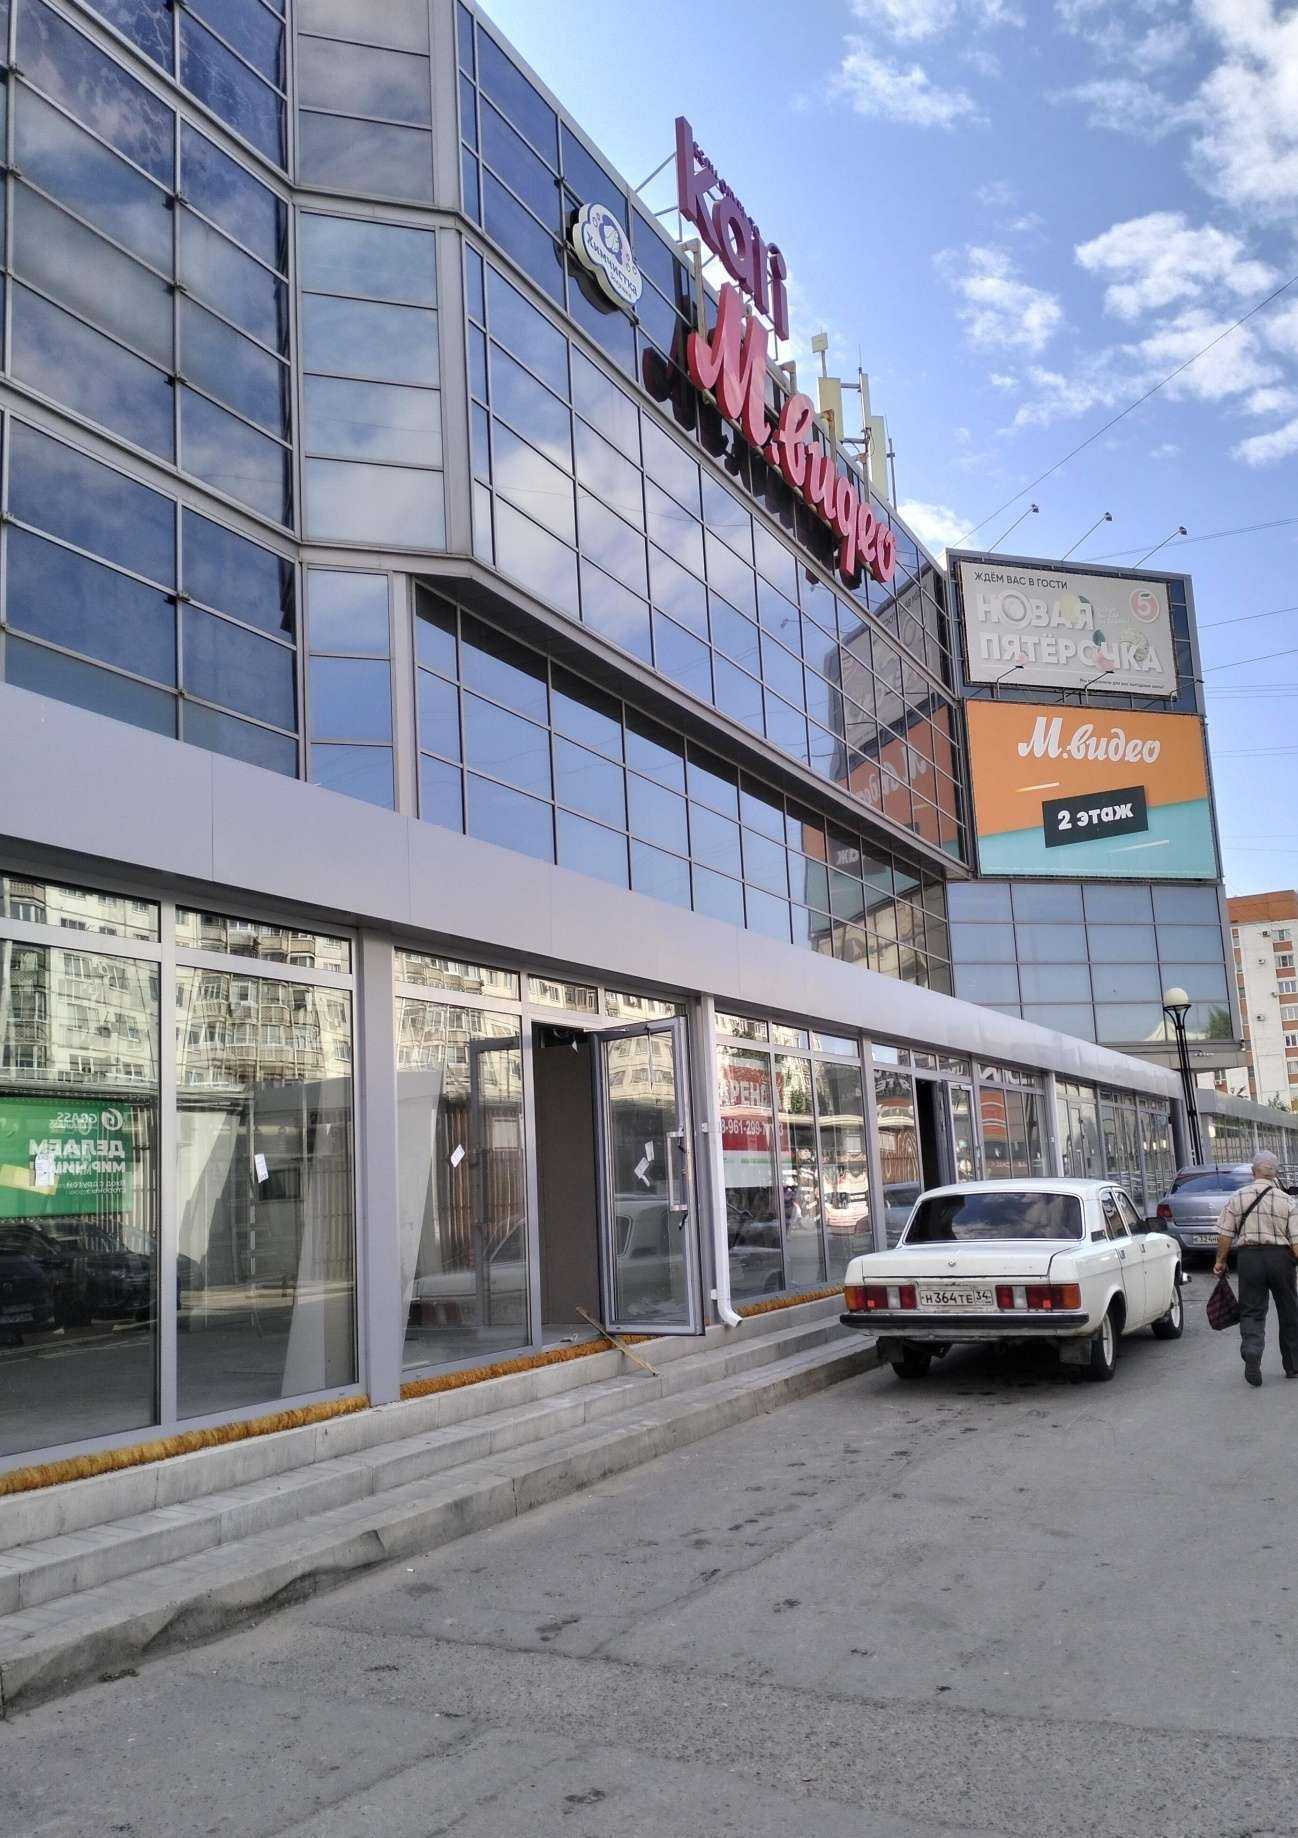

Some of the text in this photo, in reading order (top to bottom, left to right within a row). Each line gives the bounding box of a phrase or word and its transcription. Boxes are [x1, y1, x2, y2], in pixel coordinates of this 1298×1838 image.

[1007, 575, 1026, 586] ВАС
[1028, 577, 1035, 586] В
[1037, 579, 1068, 590] ГОСТИ
[977, 590, 1093, 630] НОВАЯ
[980, 631, 1163, 673] ПЯТЁРОЧКА
[1018, 716, 1161, 764] М.видео
[1057, 802, 1133, 831] 2 этаж
[976, 1291, 988, 1300] 34
